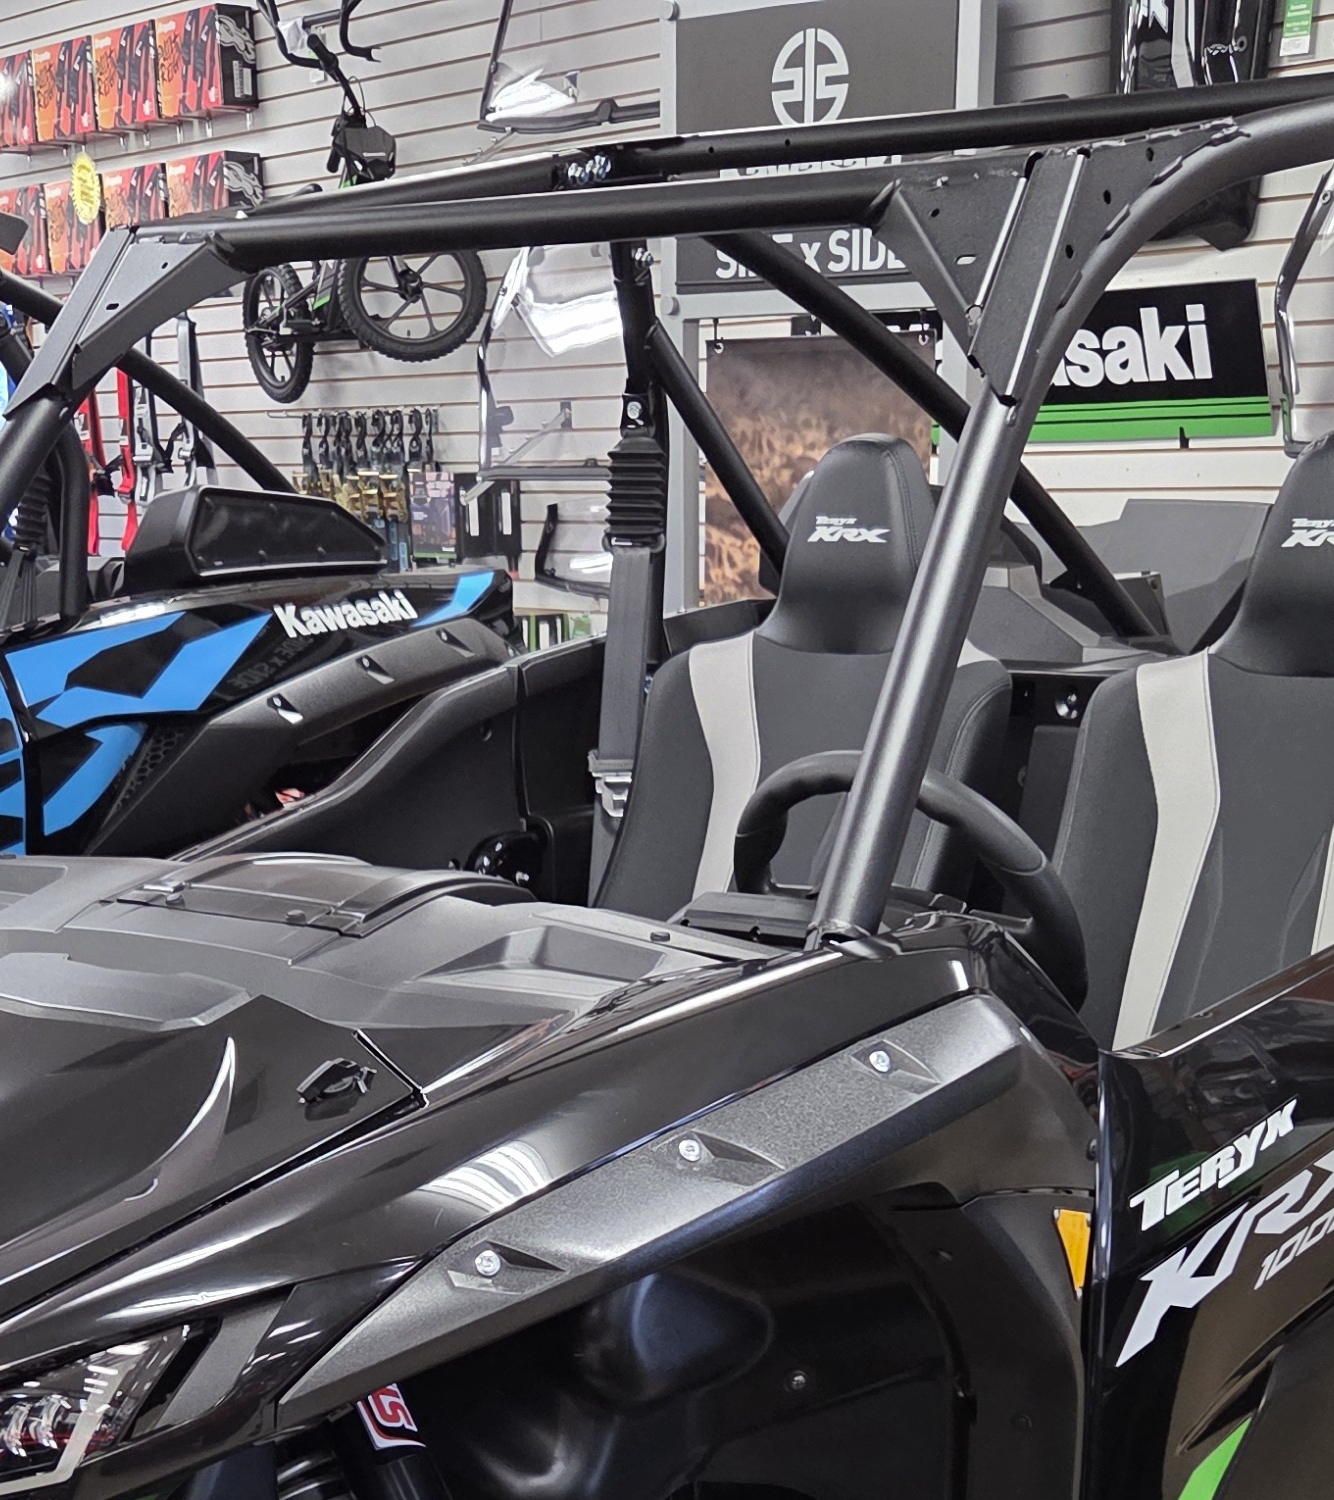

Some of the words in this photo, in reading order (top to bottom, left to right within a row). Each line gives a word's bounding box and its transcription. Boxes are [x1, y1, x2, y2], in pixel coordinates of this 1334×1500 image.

[807, 526, 891, 543] KRX
[272, 589, 418, 638] Kawasaki
[1129, 1099, 1297, 1232] TERYX
